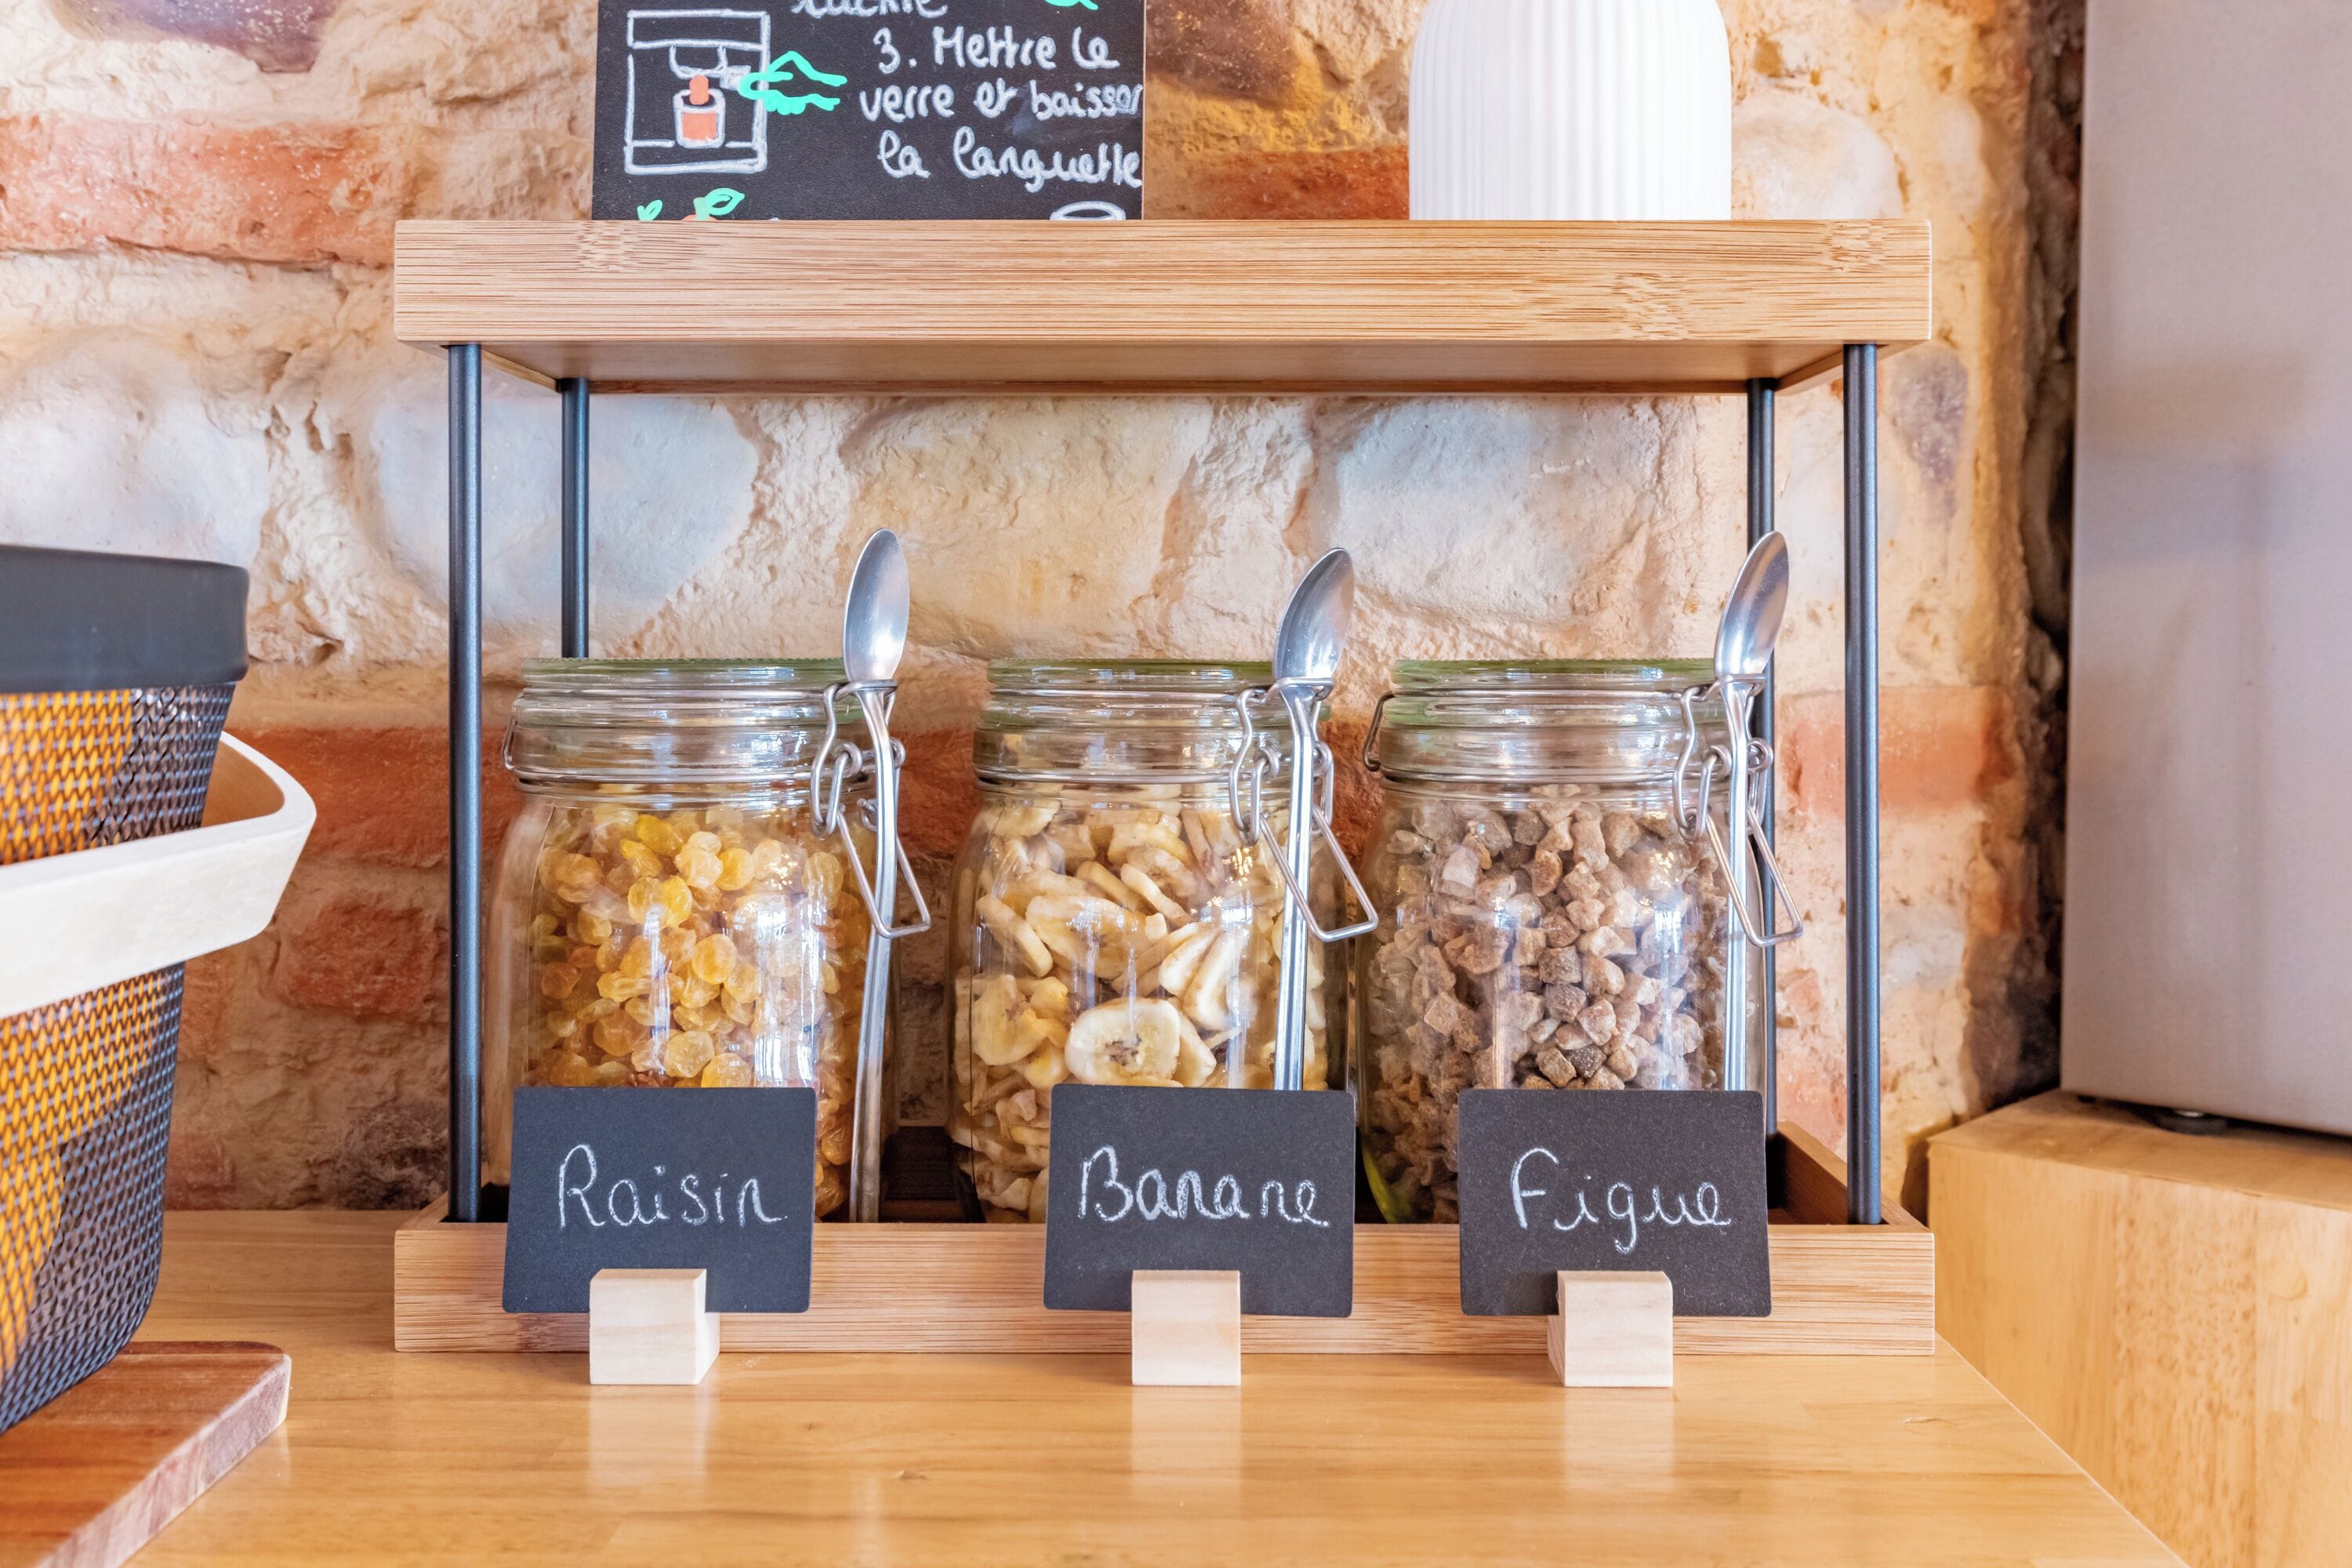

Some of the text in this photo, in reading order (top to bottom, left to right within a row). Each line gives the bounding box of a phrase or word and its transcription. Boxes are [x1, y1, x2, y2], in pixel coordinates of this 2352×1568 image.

[873, 25, 1121, 74] 3. Mettre le
[858, 78, 1143, 123] verre et baisser
[877, 126, 1143, 194] la languette
[559, 1144, 787, 1229] Raisin
[1077, 1144, 1330, 1228] Banane
[1510, 1147, 1732, 1254] Figue
